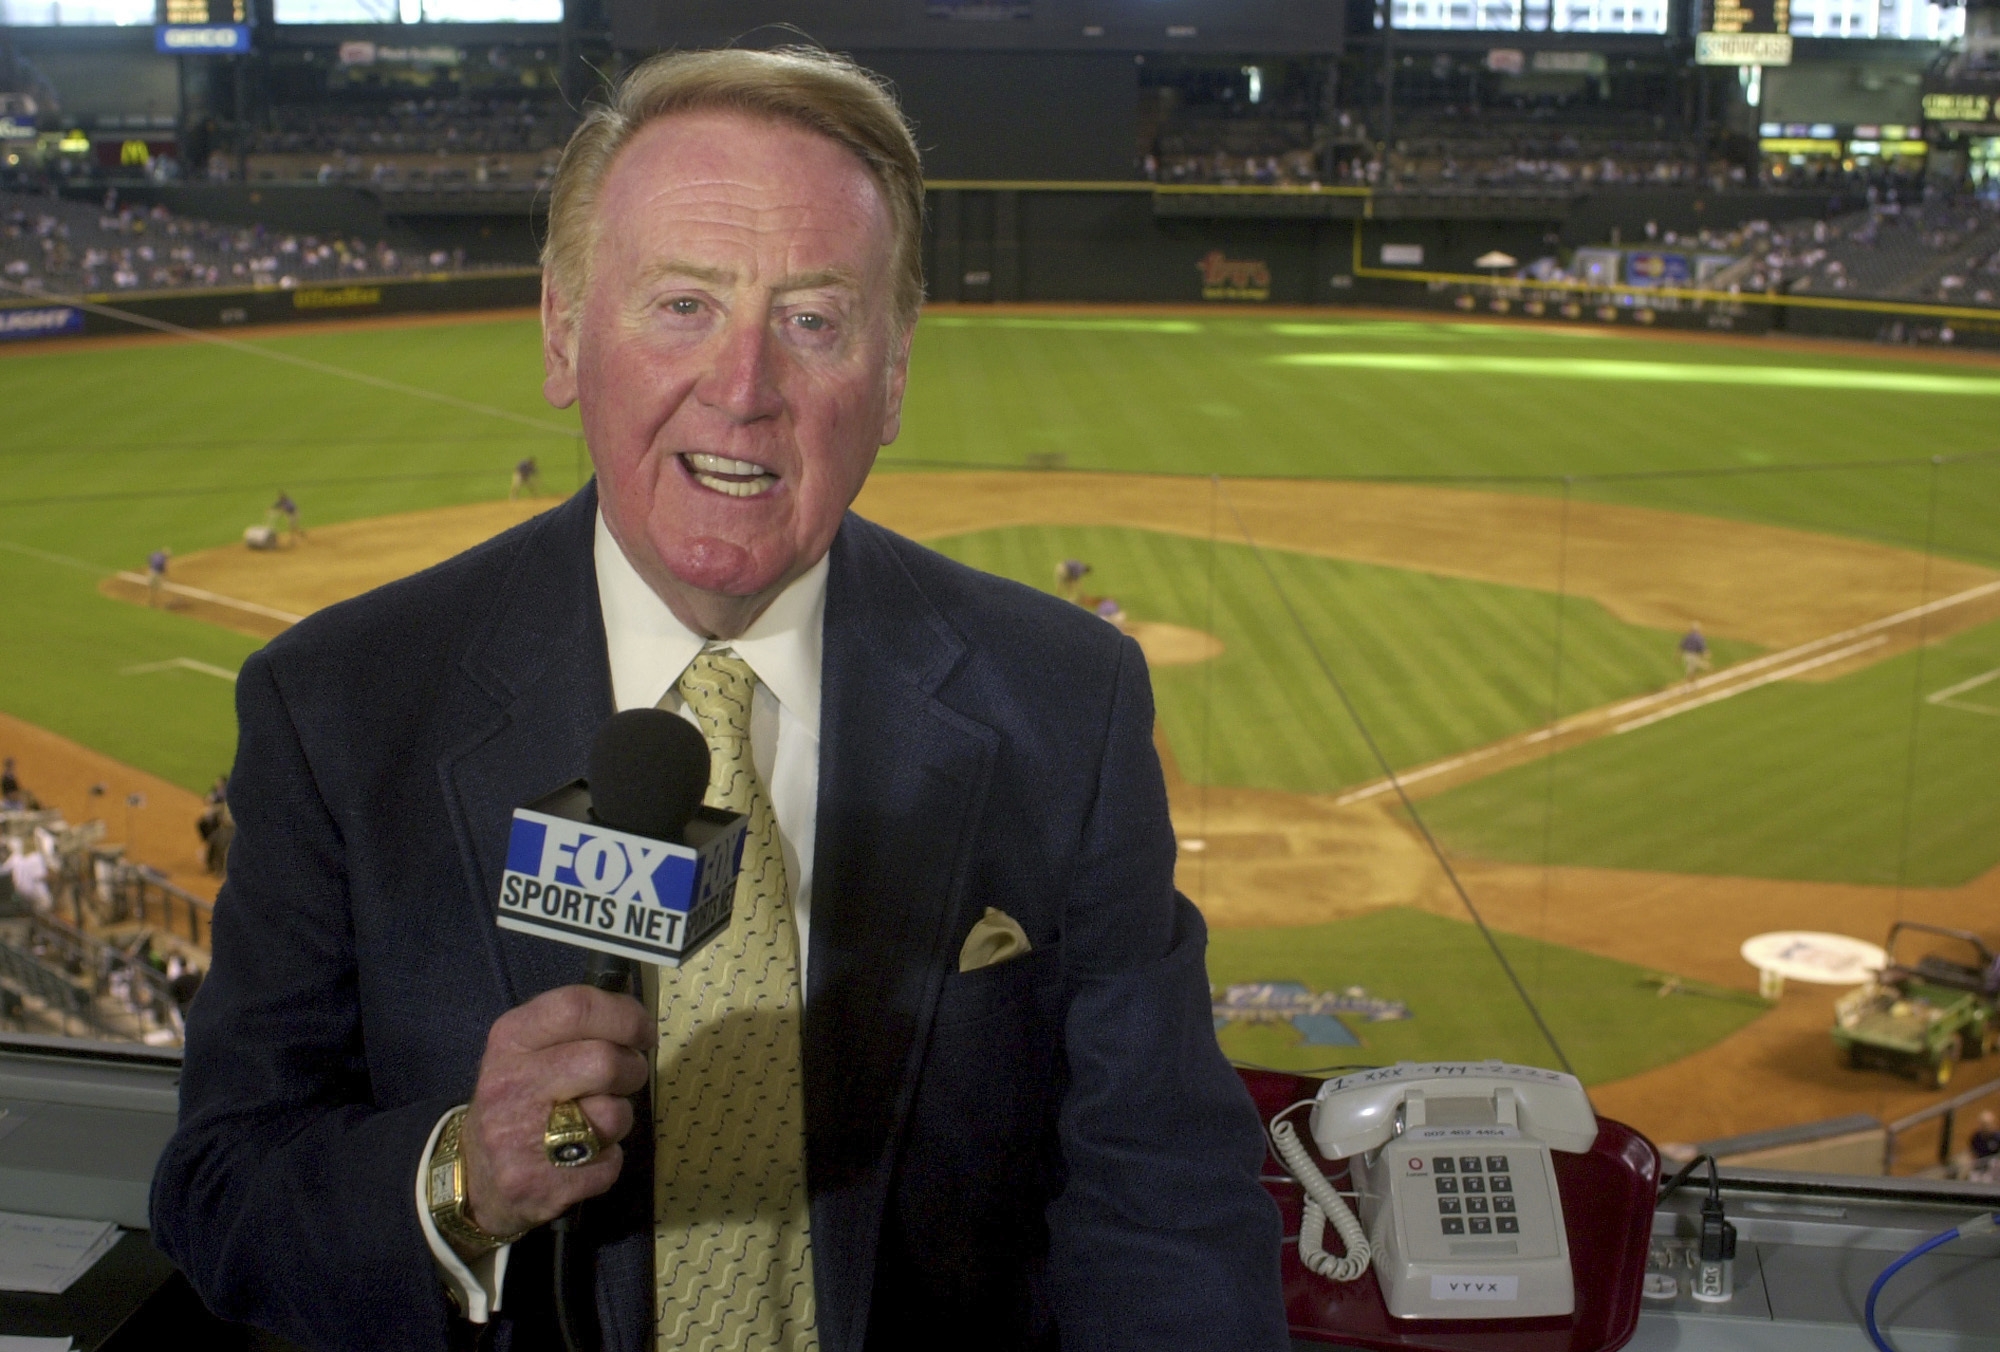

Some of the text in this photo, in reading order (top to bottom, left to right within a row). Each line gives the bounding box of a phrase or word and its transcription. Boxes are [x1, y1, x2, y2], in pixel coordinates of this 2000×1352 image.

[164, 28, 238, 48] GEICO
[538, 824, 670, 907] FOX
[503, 874, 682, 944] SPORTS NET
[1449, 1282, 1498, 1292] VYVX
